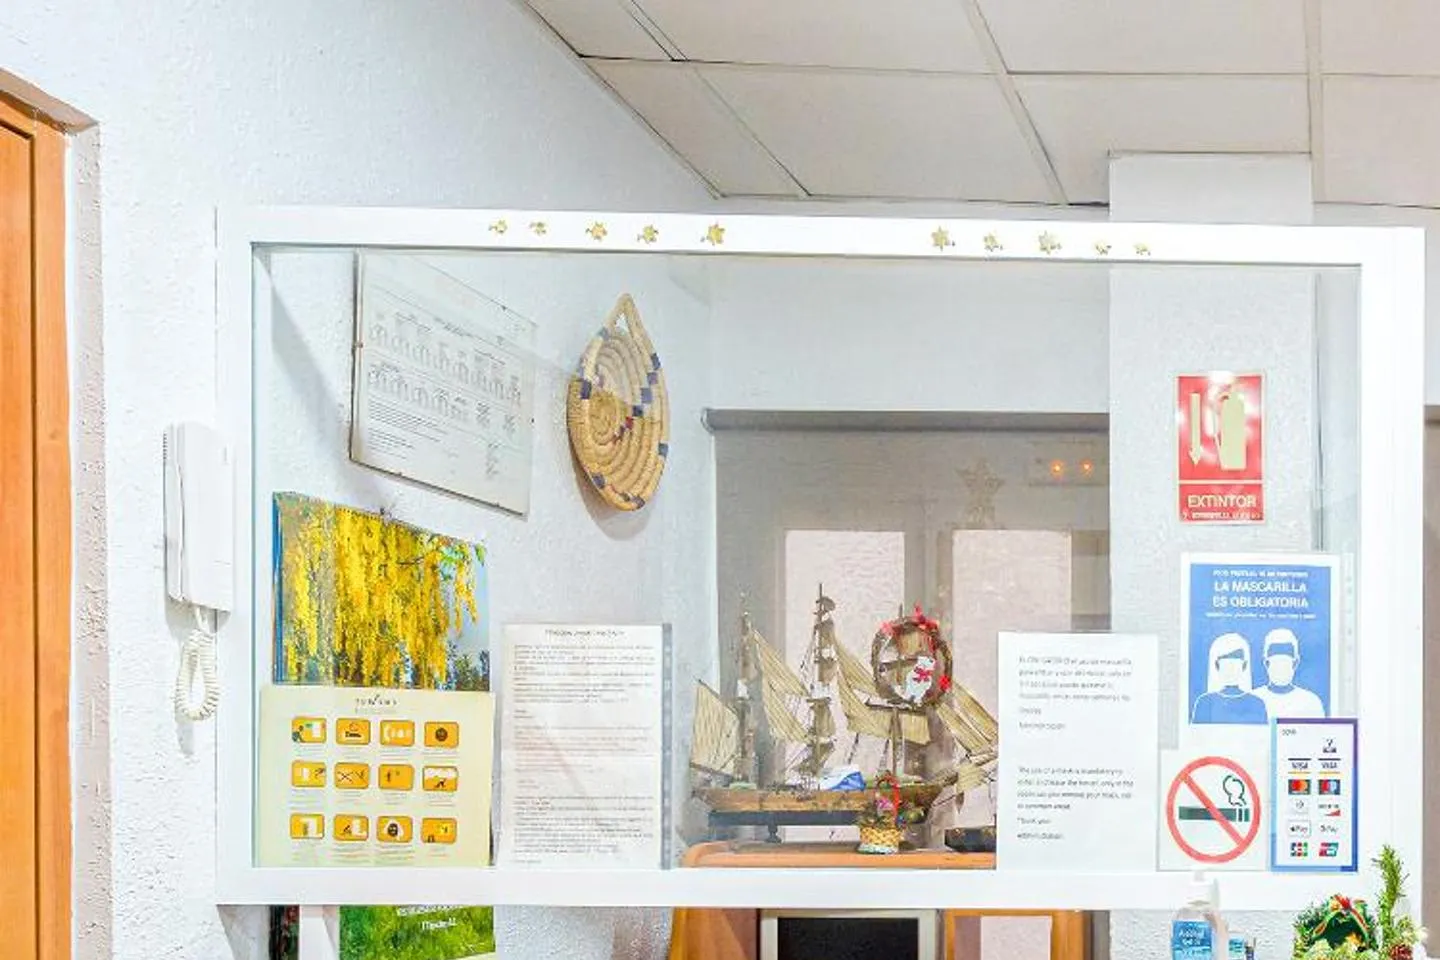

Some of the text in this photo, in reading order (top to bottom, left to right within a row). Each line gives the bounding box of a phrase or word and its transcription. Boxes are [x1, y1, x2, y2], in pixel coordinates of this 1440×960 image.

[1187, 494, 1257, 508] EXTINTOR
[1213, 580, 1307, 593] LA MASCARILLA
[1212, 595, 1309, 609] ES OBLIGATORIA
